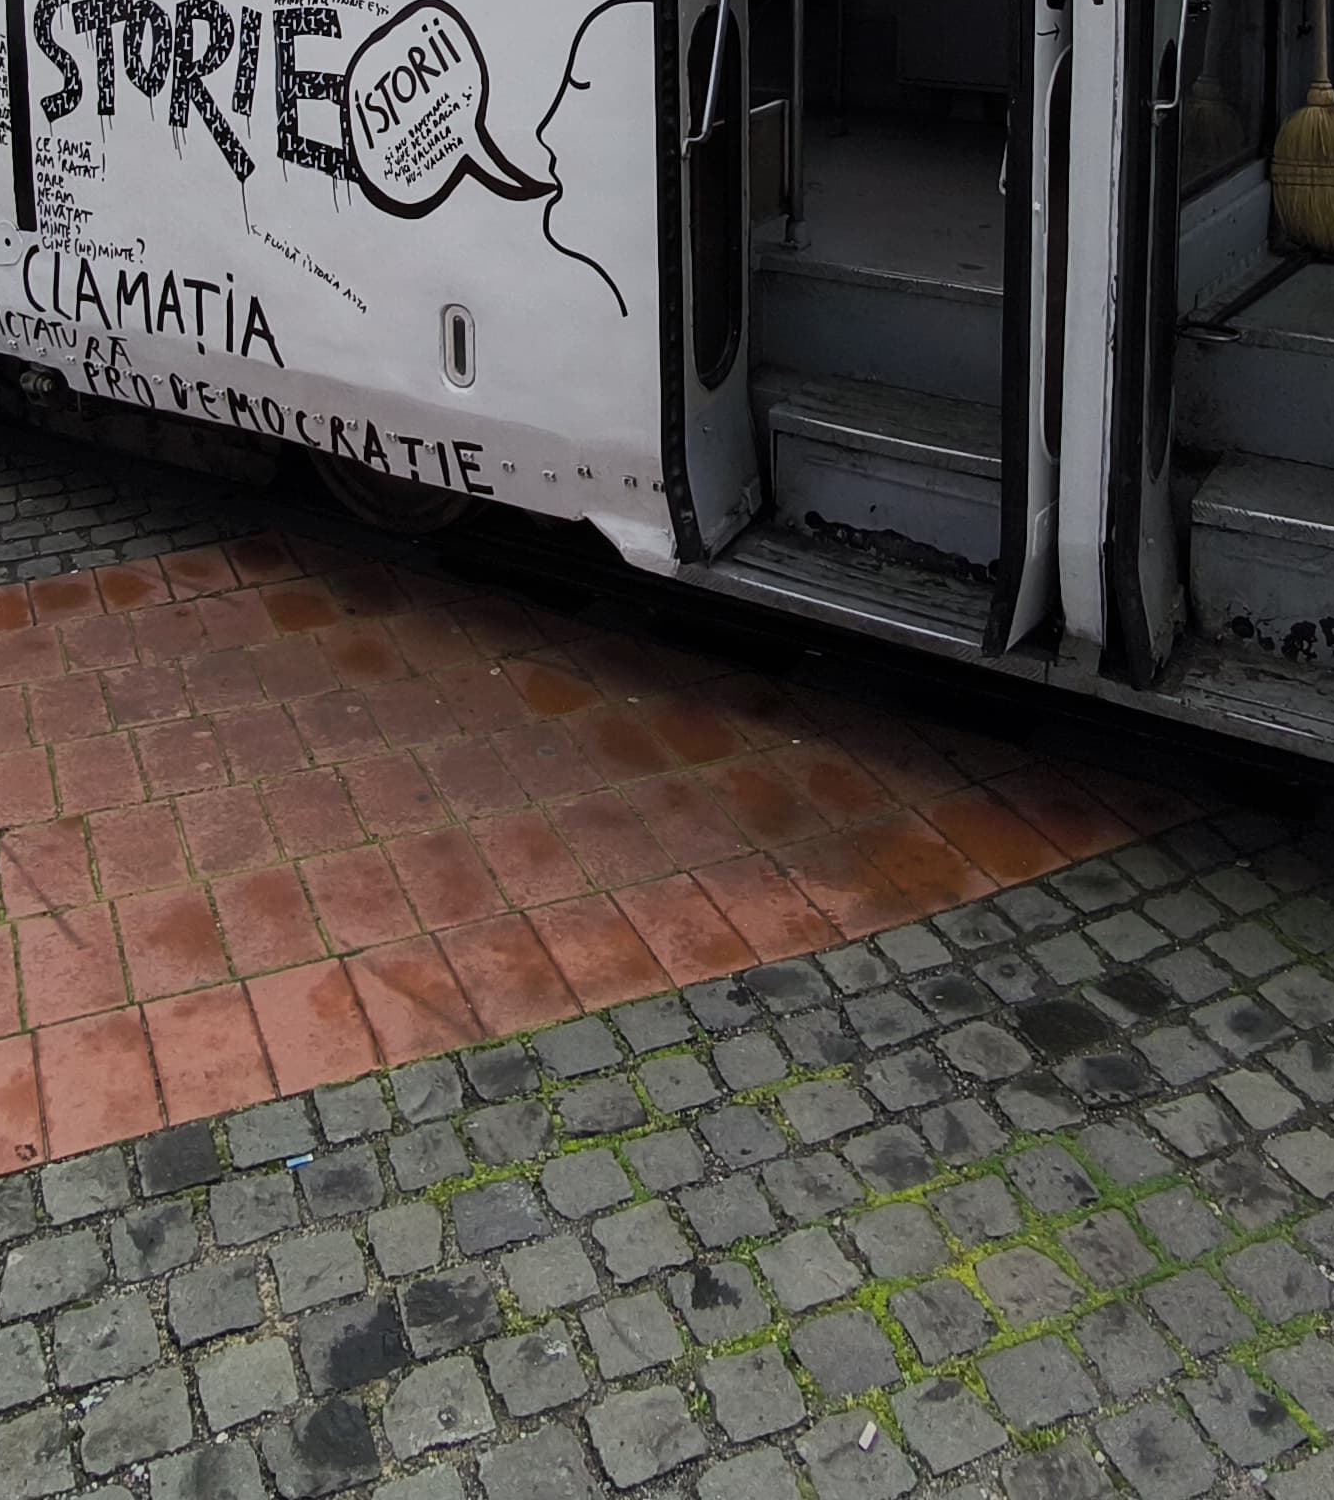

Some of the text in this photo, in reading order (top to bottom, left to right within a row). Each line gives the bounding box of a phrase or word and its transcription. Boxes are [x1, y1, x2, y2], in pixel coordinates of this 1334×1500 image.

[354, 17, 462, 150] ISTORII
[36, 136, 51, 152] CE
[35, 153, 55, 169] AM
[83, 360, 157, 409] PRO
